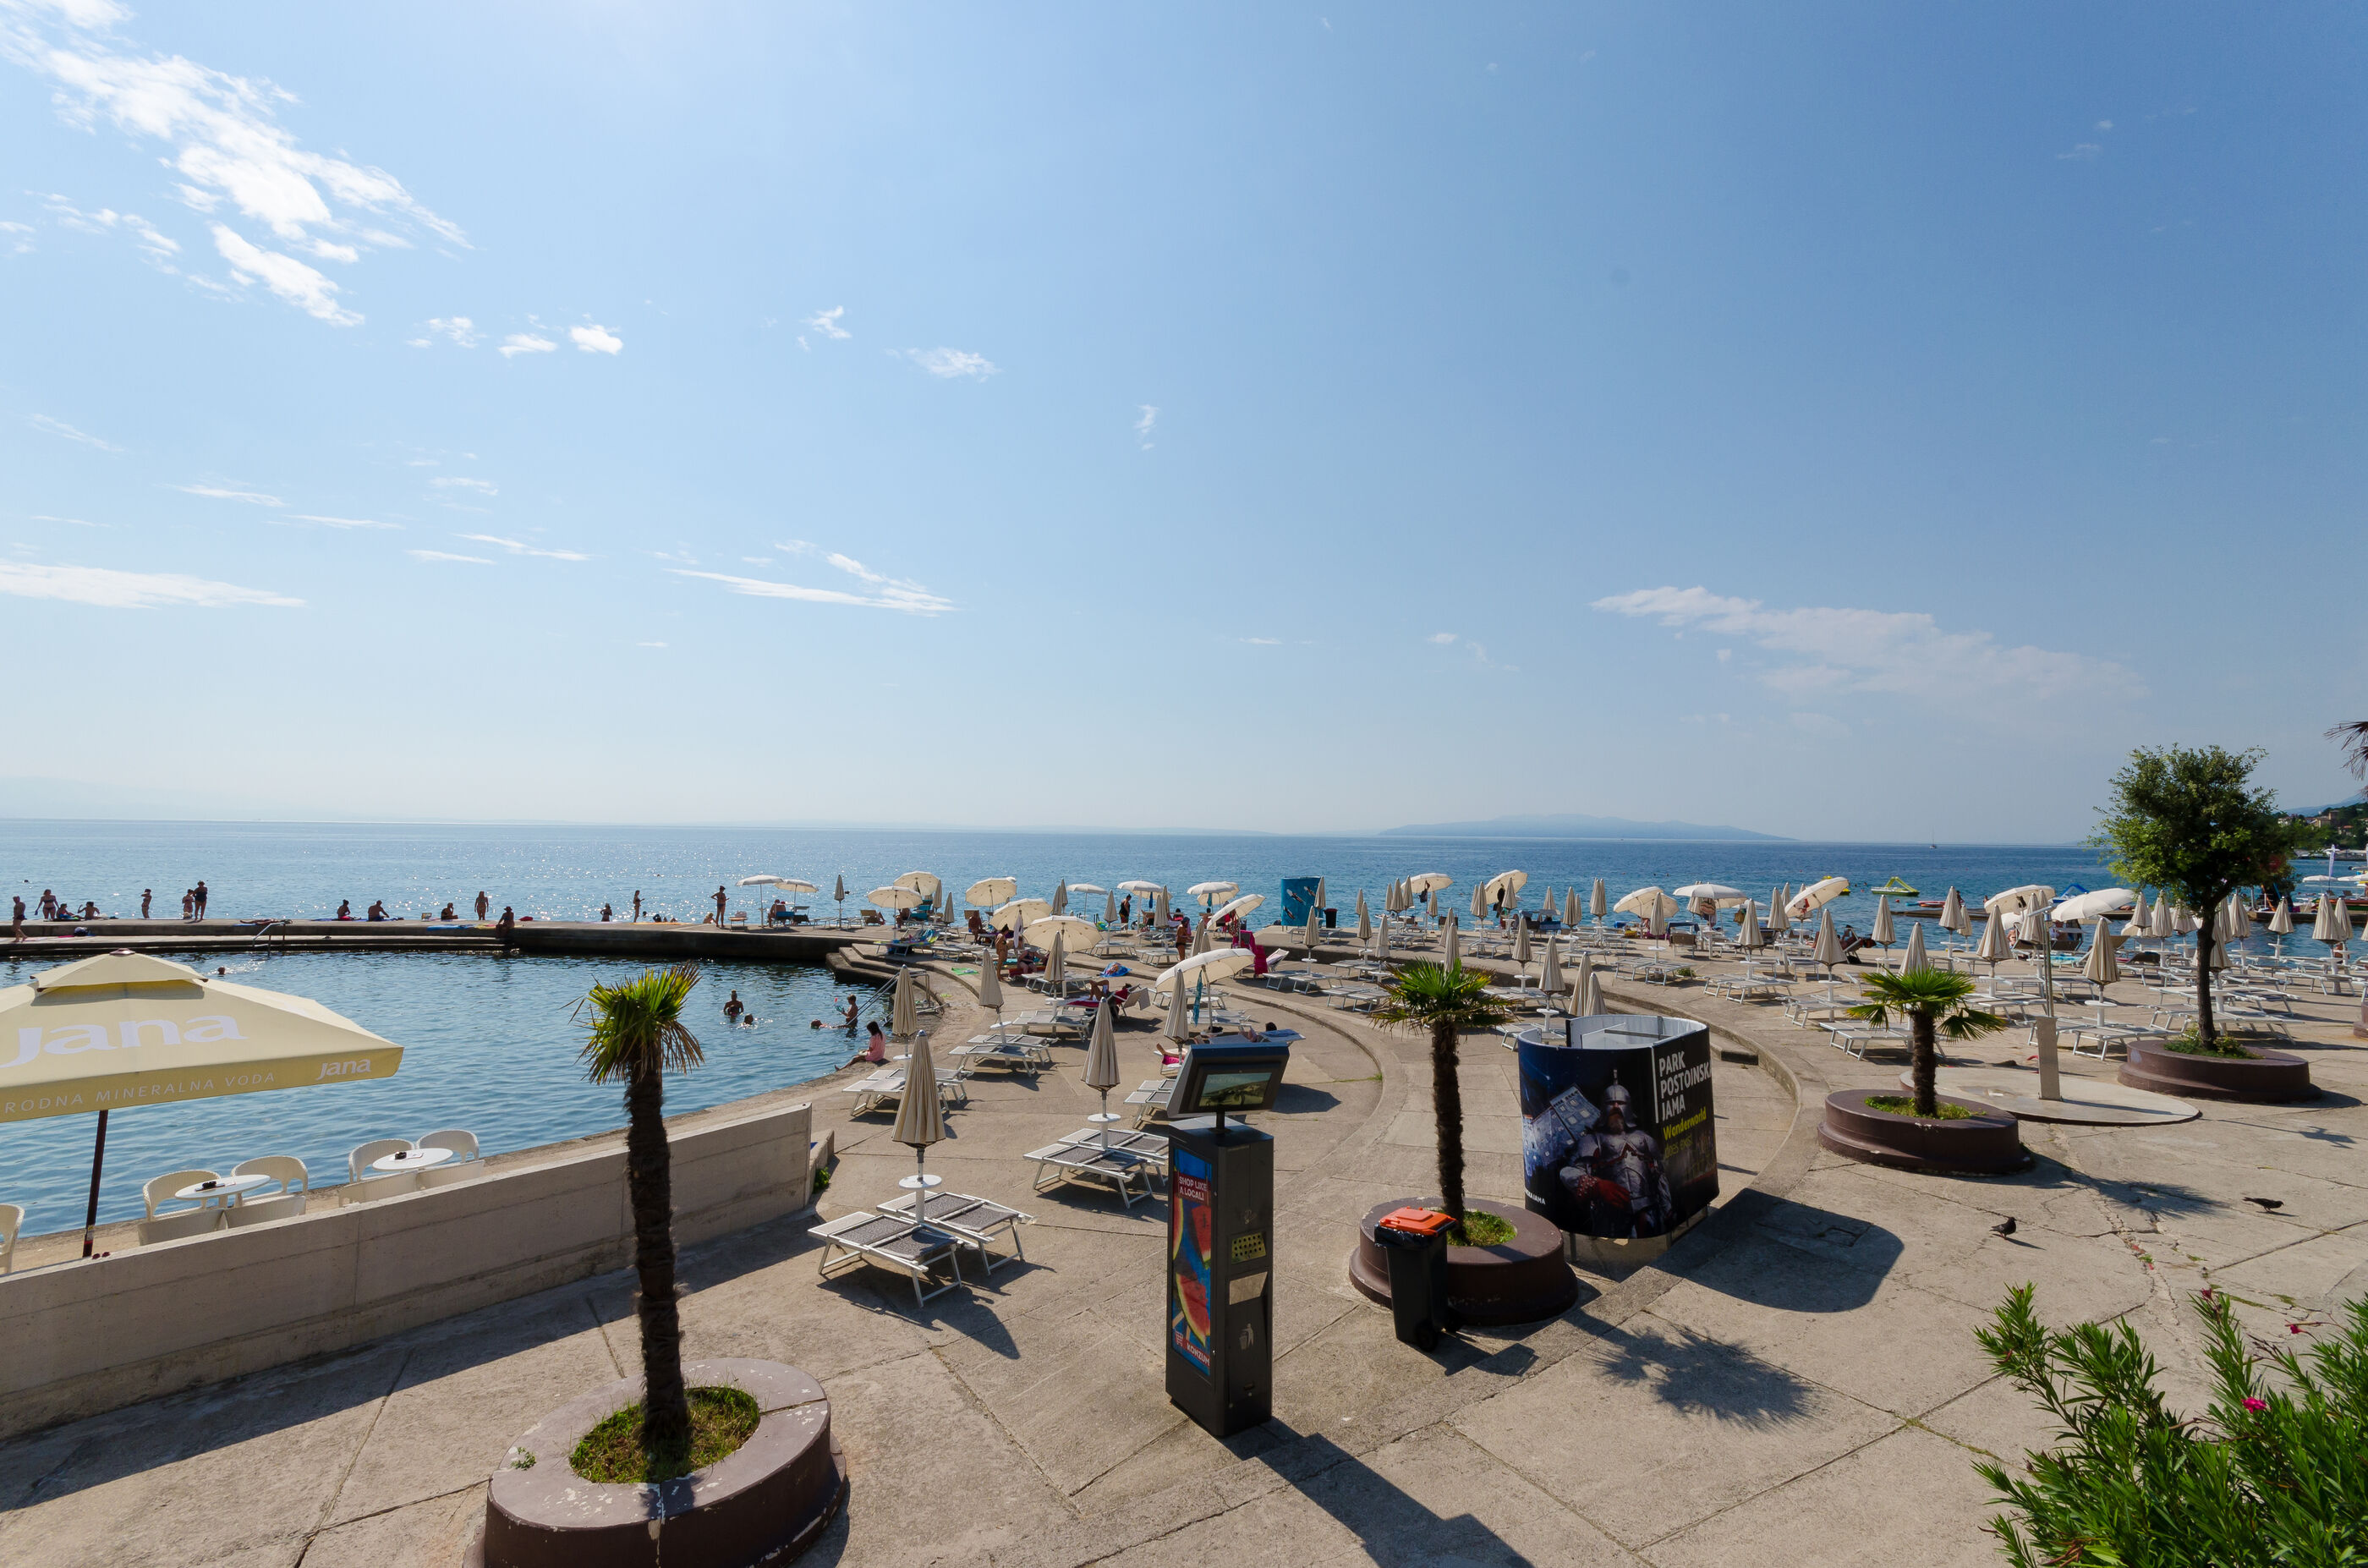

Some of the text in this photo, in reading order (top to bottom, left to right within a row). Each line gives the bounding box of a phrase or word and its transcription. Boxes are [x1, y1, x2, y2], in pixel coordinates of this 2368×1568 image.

[1658, 1050, 1686, 1077] PARK
[96, 1079, 214, 1101] MINERALNA
[225, 1072, 275, 1087] VODA
[1179, 1176, 1207, 1192] SHOP LIKE
[1180, 1186, 1184, 1195] A
[1187, 1342, 1209, 1367] KONZUM
